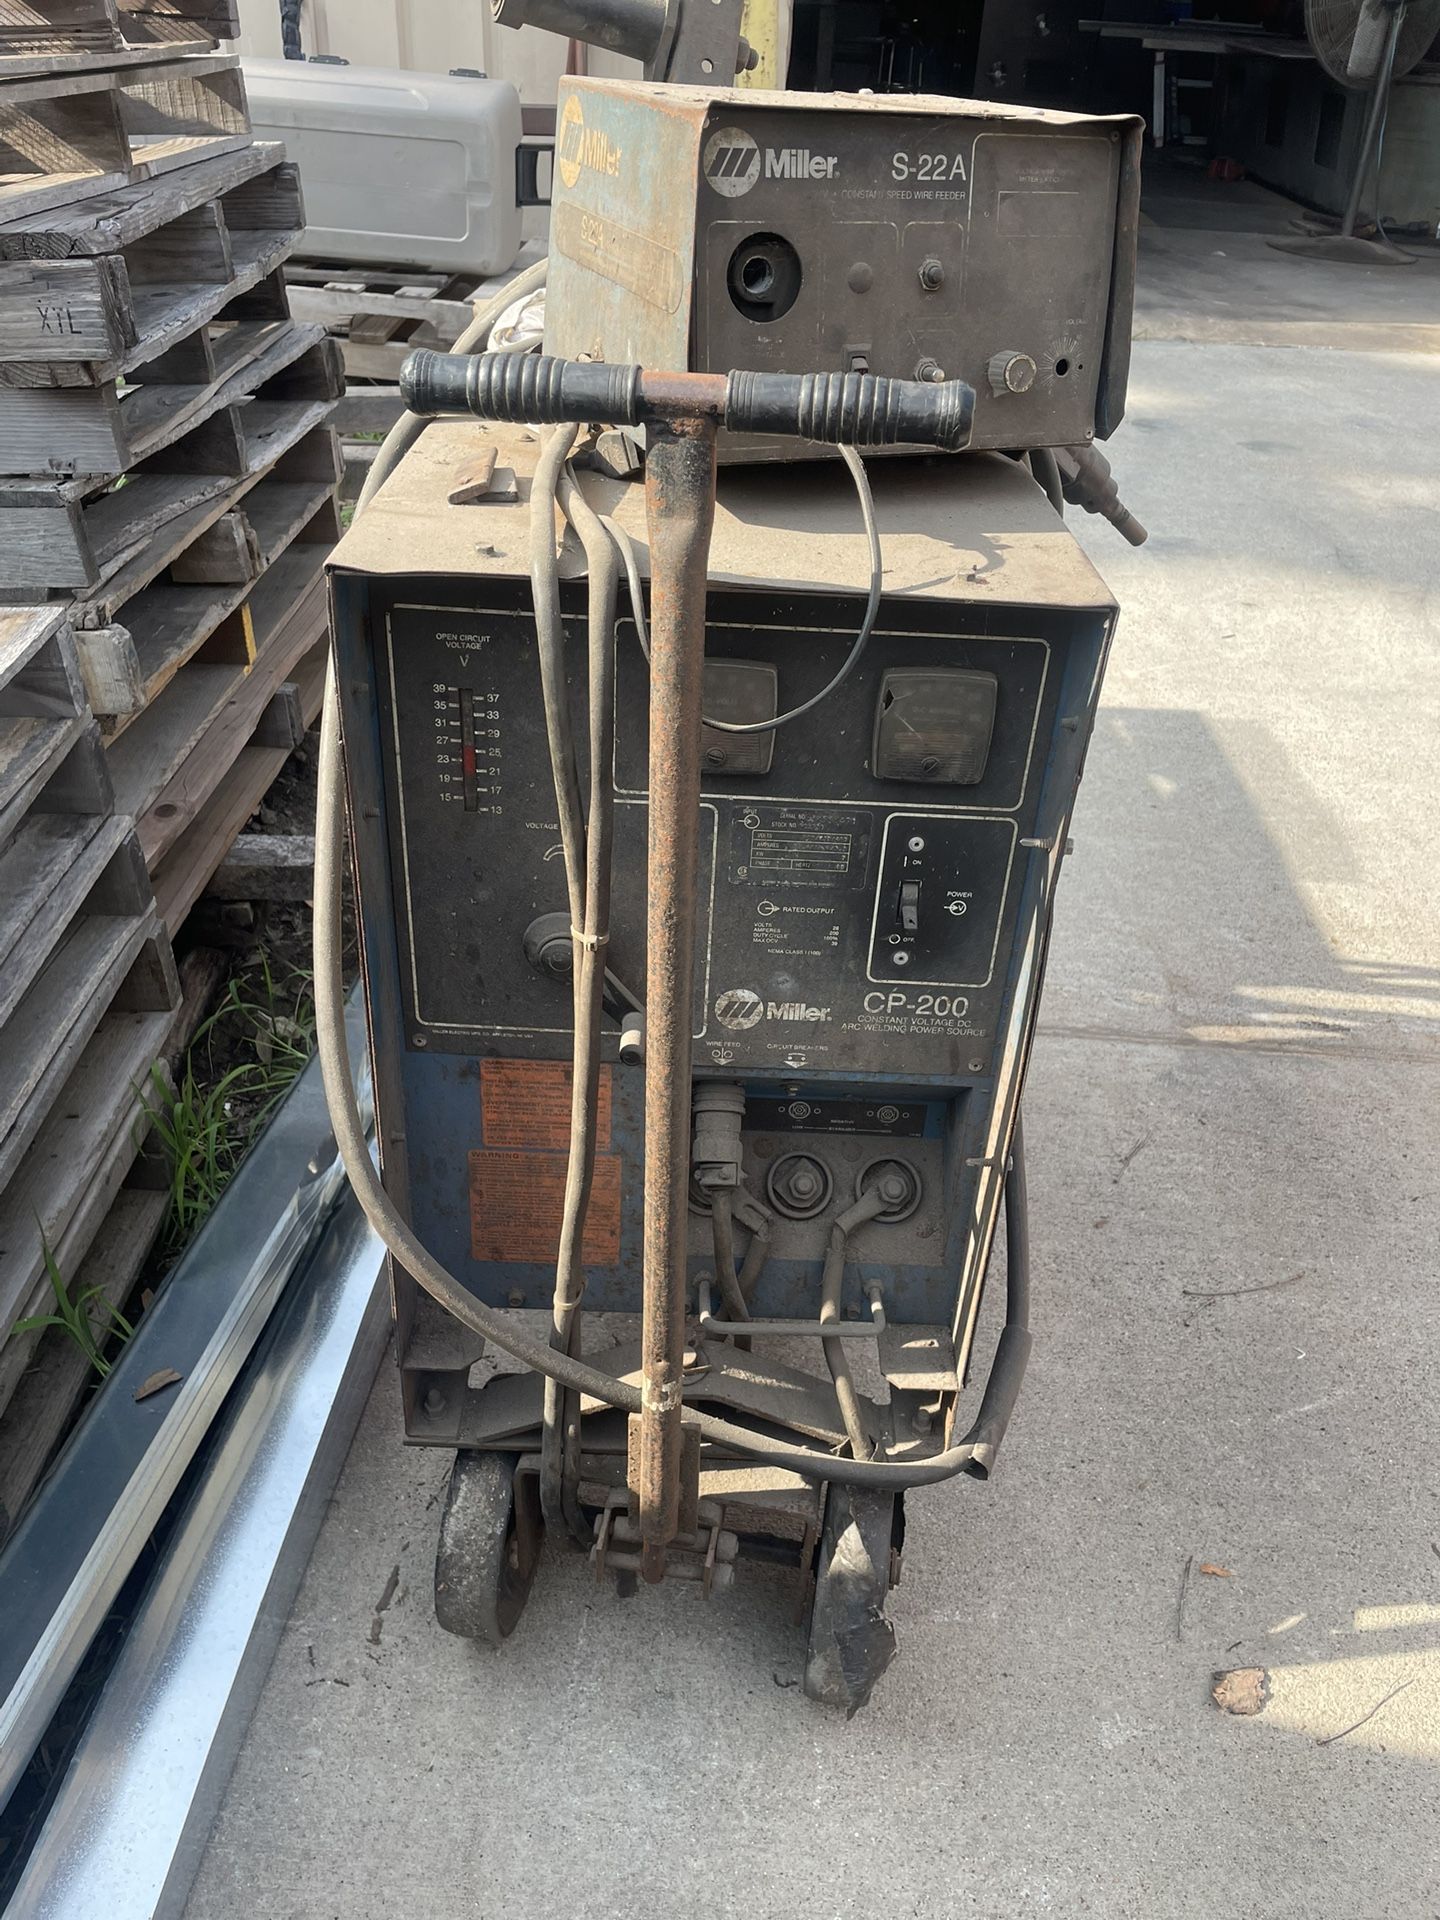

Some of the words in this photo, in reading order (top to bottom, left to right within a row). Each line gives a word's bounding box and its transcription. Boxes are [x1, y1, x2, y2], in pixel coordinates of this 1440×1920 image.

[583, 127, 622, 177] Miller
[764, 148, 838, 179] Miller
[891, 152, 967, 181] S-22A
[886, 190, 912, 200] SPEED
[914, 190, 933, 200] WIRE
[935, 190, 966, 200] FEEDER
[436, 632, 458, 641] OPEN
[460, 634, 491, 643] CIRCUIT
[445, 641, 482, 650] VOLTAGE
[460, 655, 469, 667] V
[432, 683, 446, 693] 39
[487, 693, 500, 703] 37
[433, 700, 447, 710] 35
[486, 710, 500, 720] 33
[434, 718, 447, 727] 31
[487, 729, 500, 738] 29
[436, 735, 449, 745] 27
[488, 747, 501, 757] 25
[437, 754, 450, 764] 23
[489, 767, 501, 776] 21
[439, 774, 451, 783] 19
[491, 786, 502, 795] 17
[440, 792, 452, 802] 15
[491, 806, 503, 815] 13
[525, 822, 559, 830] VOLTAGE
[946, 890, 973, 898] POWER
[782, 906, 805, 914] RATED
[863, 991, 969, 1018] CP-200
[766, 1002, 831, 1022] Miller
[857, 1014, 908, 1025] CONSTANT
[910, 1017, 955, 1027] VOLTAGE
[957, 1020, 972, 1028] DC
[841, 1023, 862, 1033] ARC
[864, 1024, 907, 1034] WELDING
[946, 1027, 987, 1037] SOURCE
